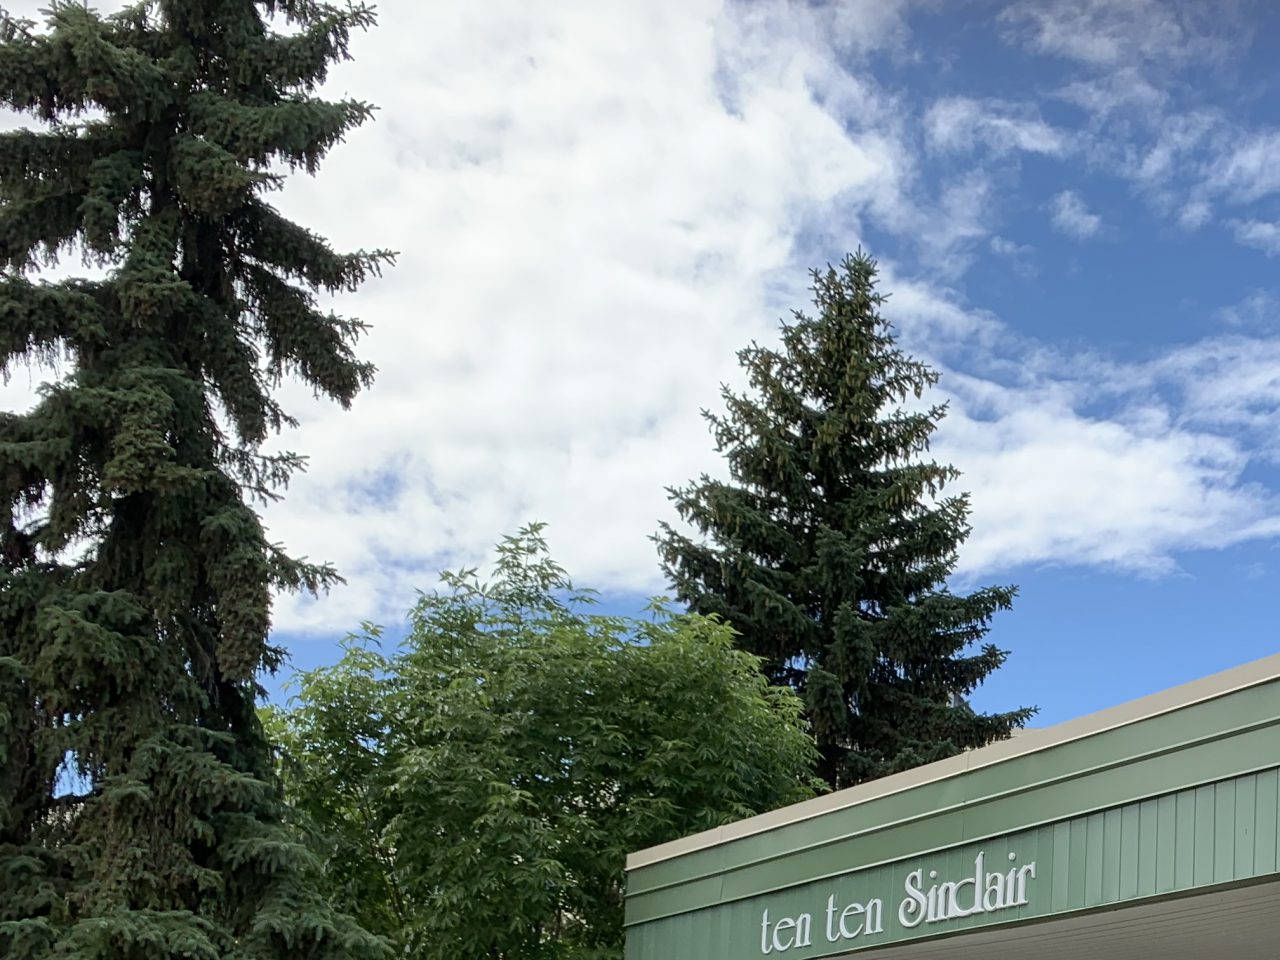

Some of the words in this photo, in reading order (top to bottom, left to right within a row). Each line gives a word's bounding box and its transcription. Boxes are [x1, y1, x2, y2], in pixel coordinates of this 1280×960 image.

[761, 908, 812, 954] ten
[825, 893, 884, 942] ten
[898, 851, 1037, 928] Sinclair
